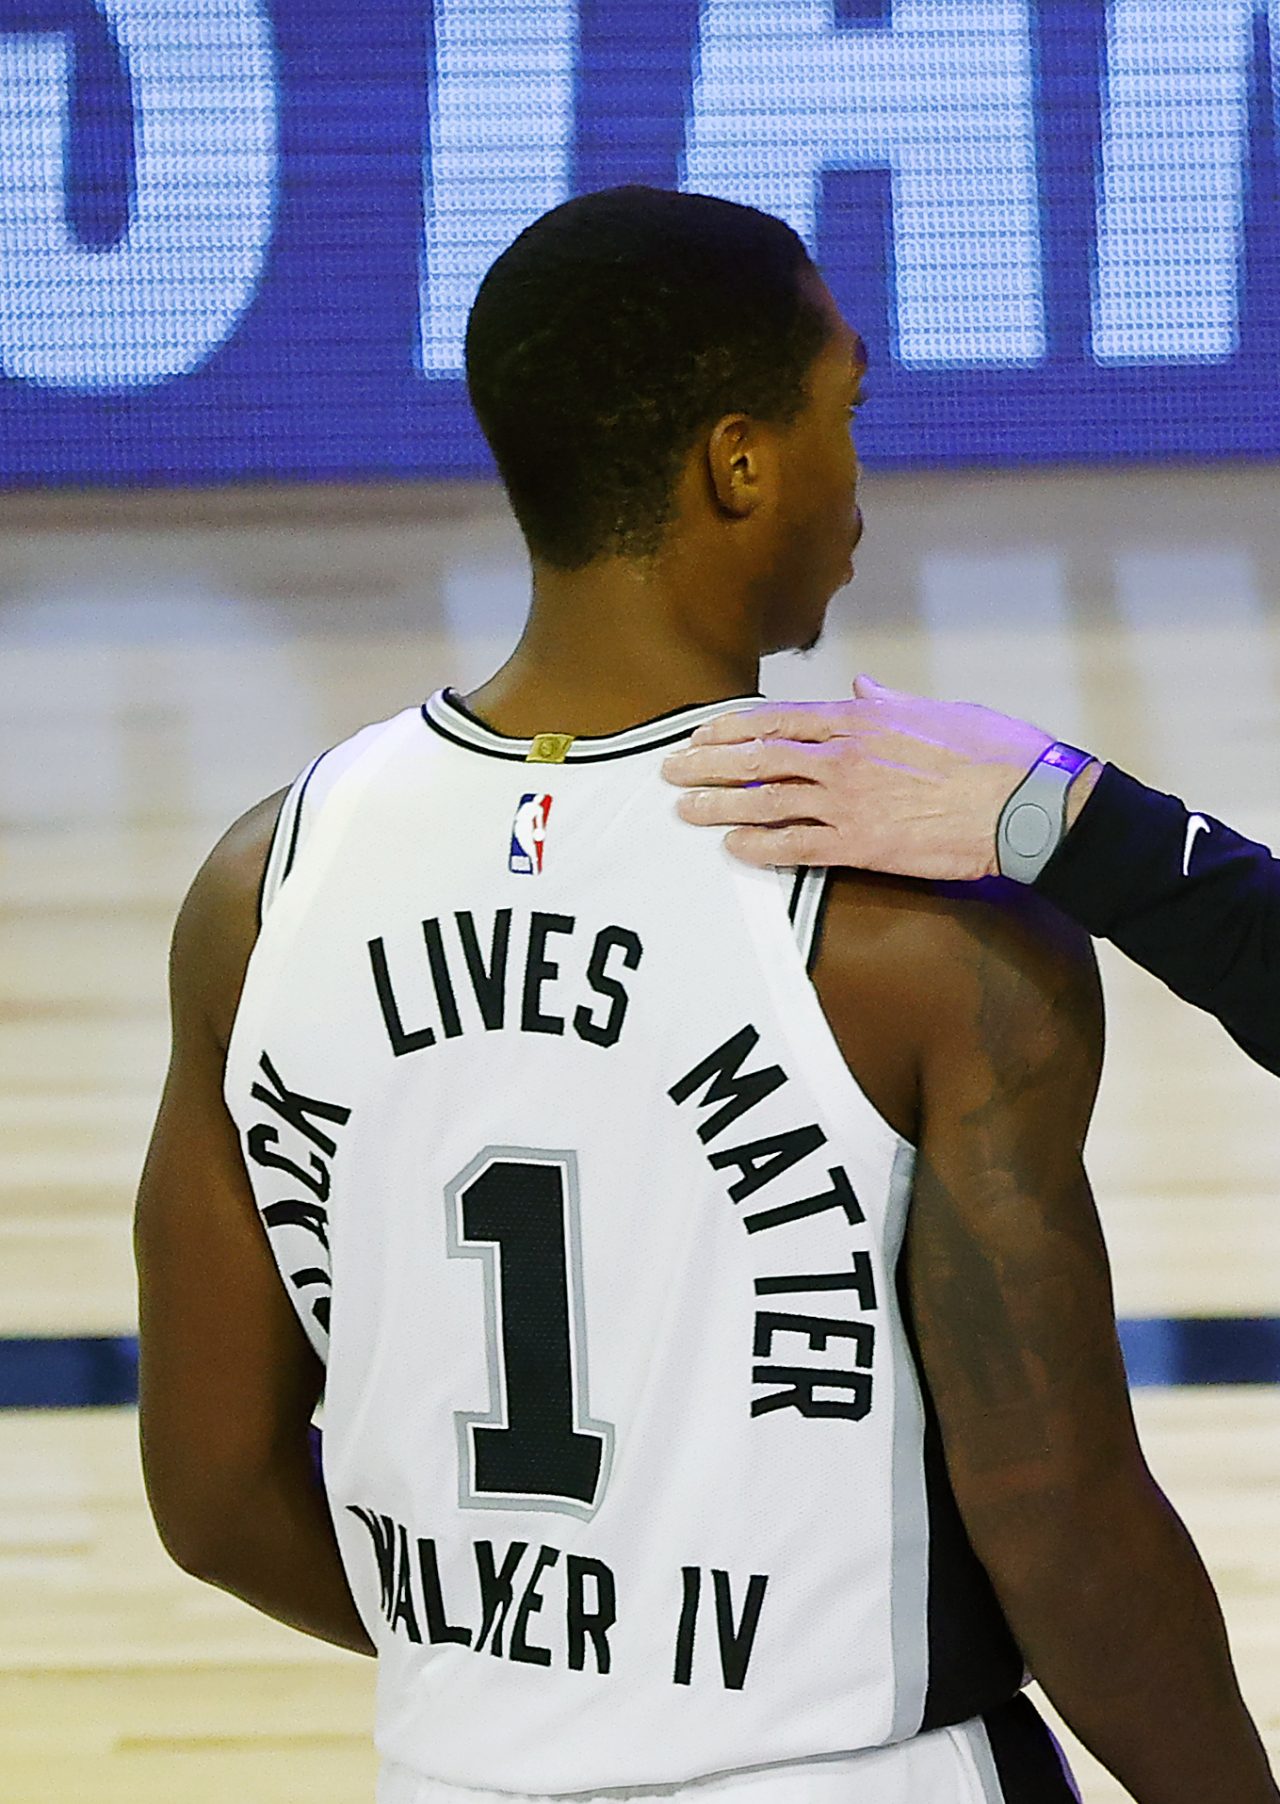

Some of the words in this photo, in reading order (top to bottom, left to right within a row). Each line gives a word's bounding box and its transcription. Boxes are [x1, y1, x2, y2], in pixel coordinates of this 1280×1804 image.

[367, 908, 643, 1057] LIVES
[667, 1023, 877, 1422] MATTER
[443, 1144, 615, 1524] 1
[345, 1504, 617, 1674] WALKER
[673, 1566, 769, 1690] IV
